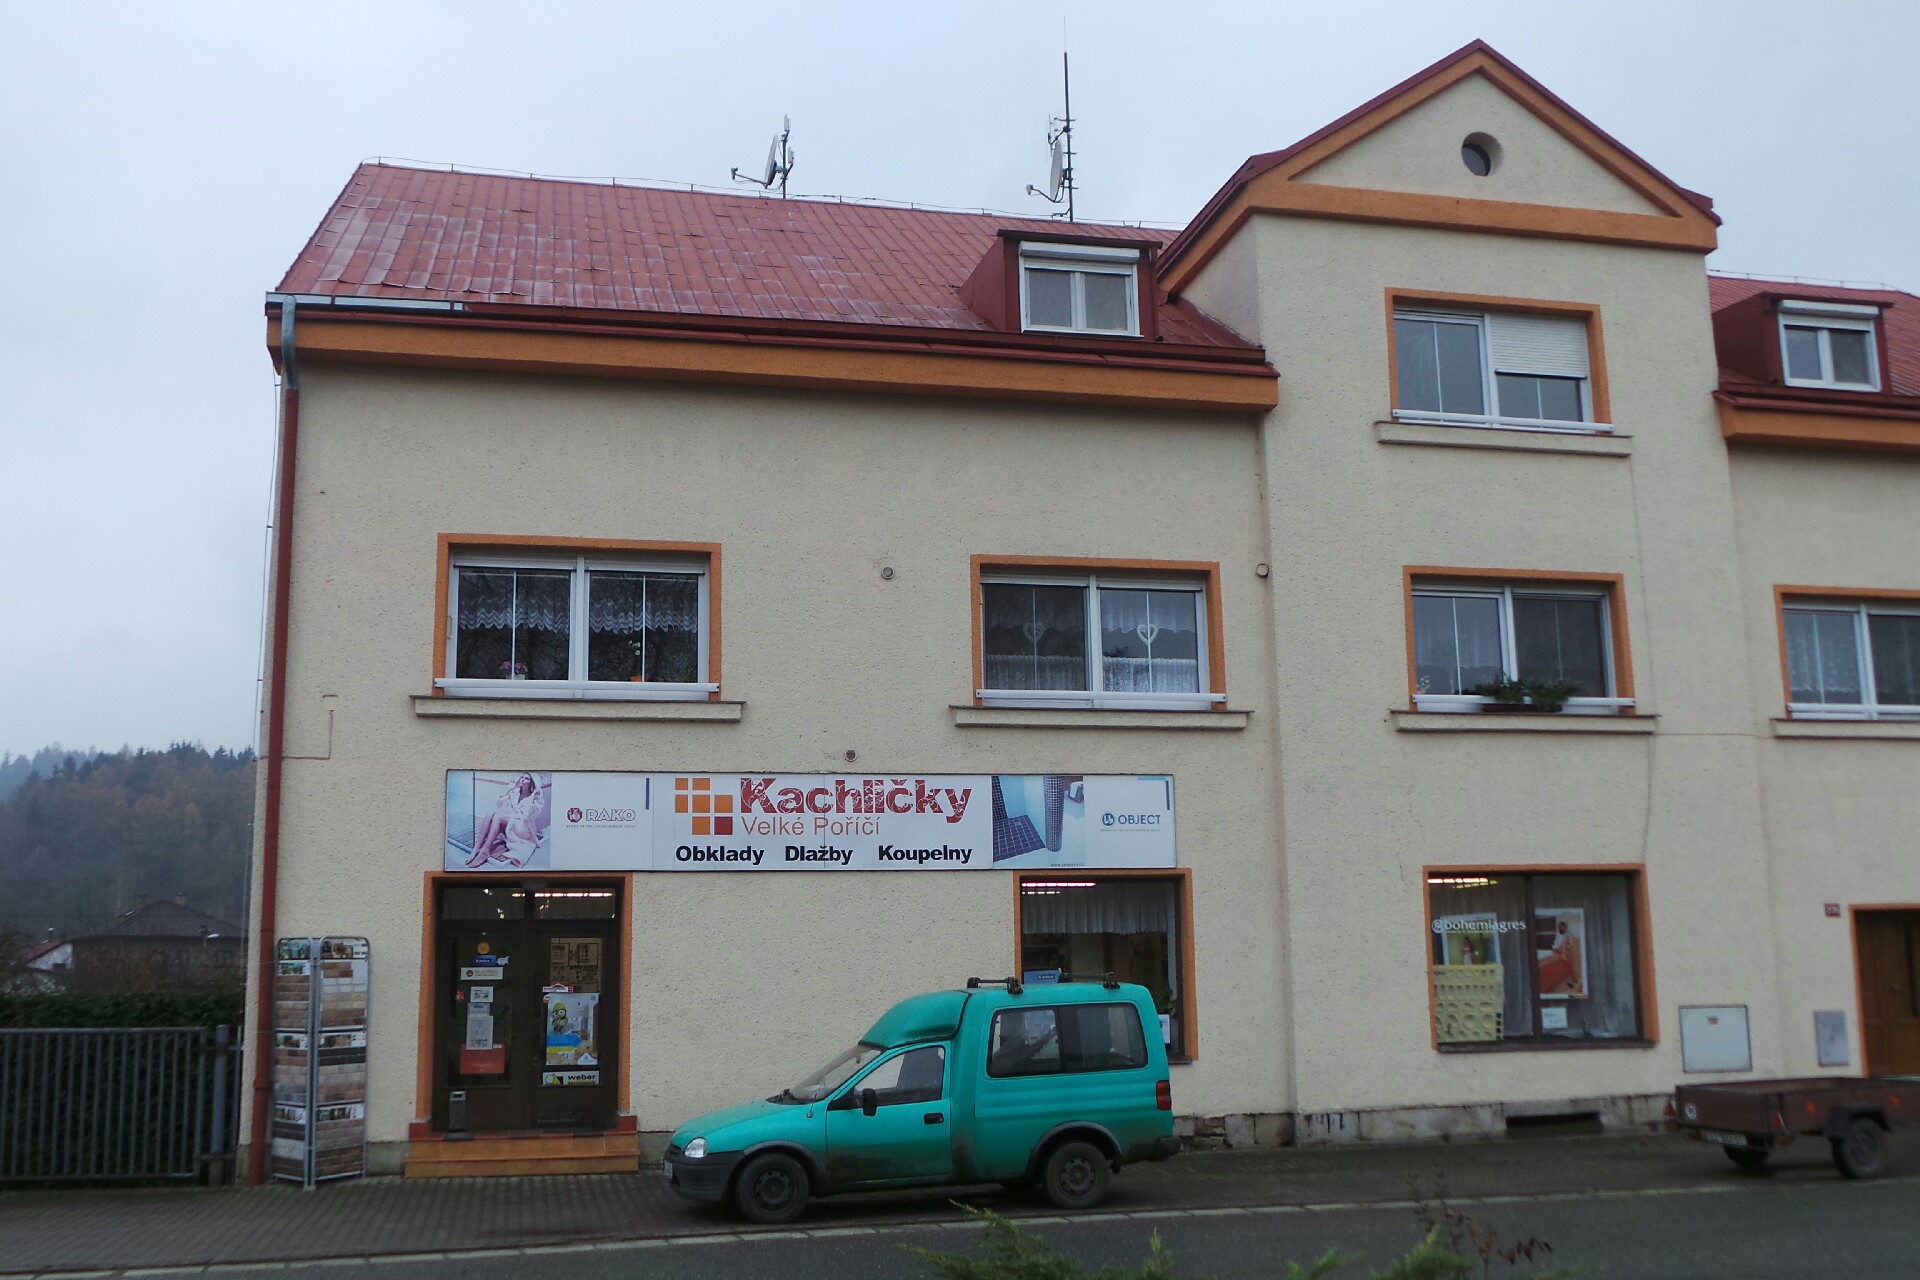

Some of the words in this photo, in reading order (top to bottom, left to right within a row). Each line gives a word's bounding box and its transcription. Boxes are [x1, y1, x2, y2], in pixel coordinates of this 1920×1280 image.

[740, 777, 973, 824] Kachličky
[586, 808, 637, 822] RAKO
[1118, 814, 1161, 825] OBJECT
[741, 816, 805, 836] Velké
[814, 816, 881, 836] Poříčí
[675, 845, 765, 866] Obklady
[785, 845, 854, 866] Dlažby
[878, 844, 973, 865] Koupelny
[567, 1073, 596, 1081] weber
